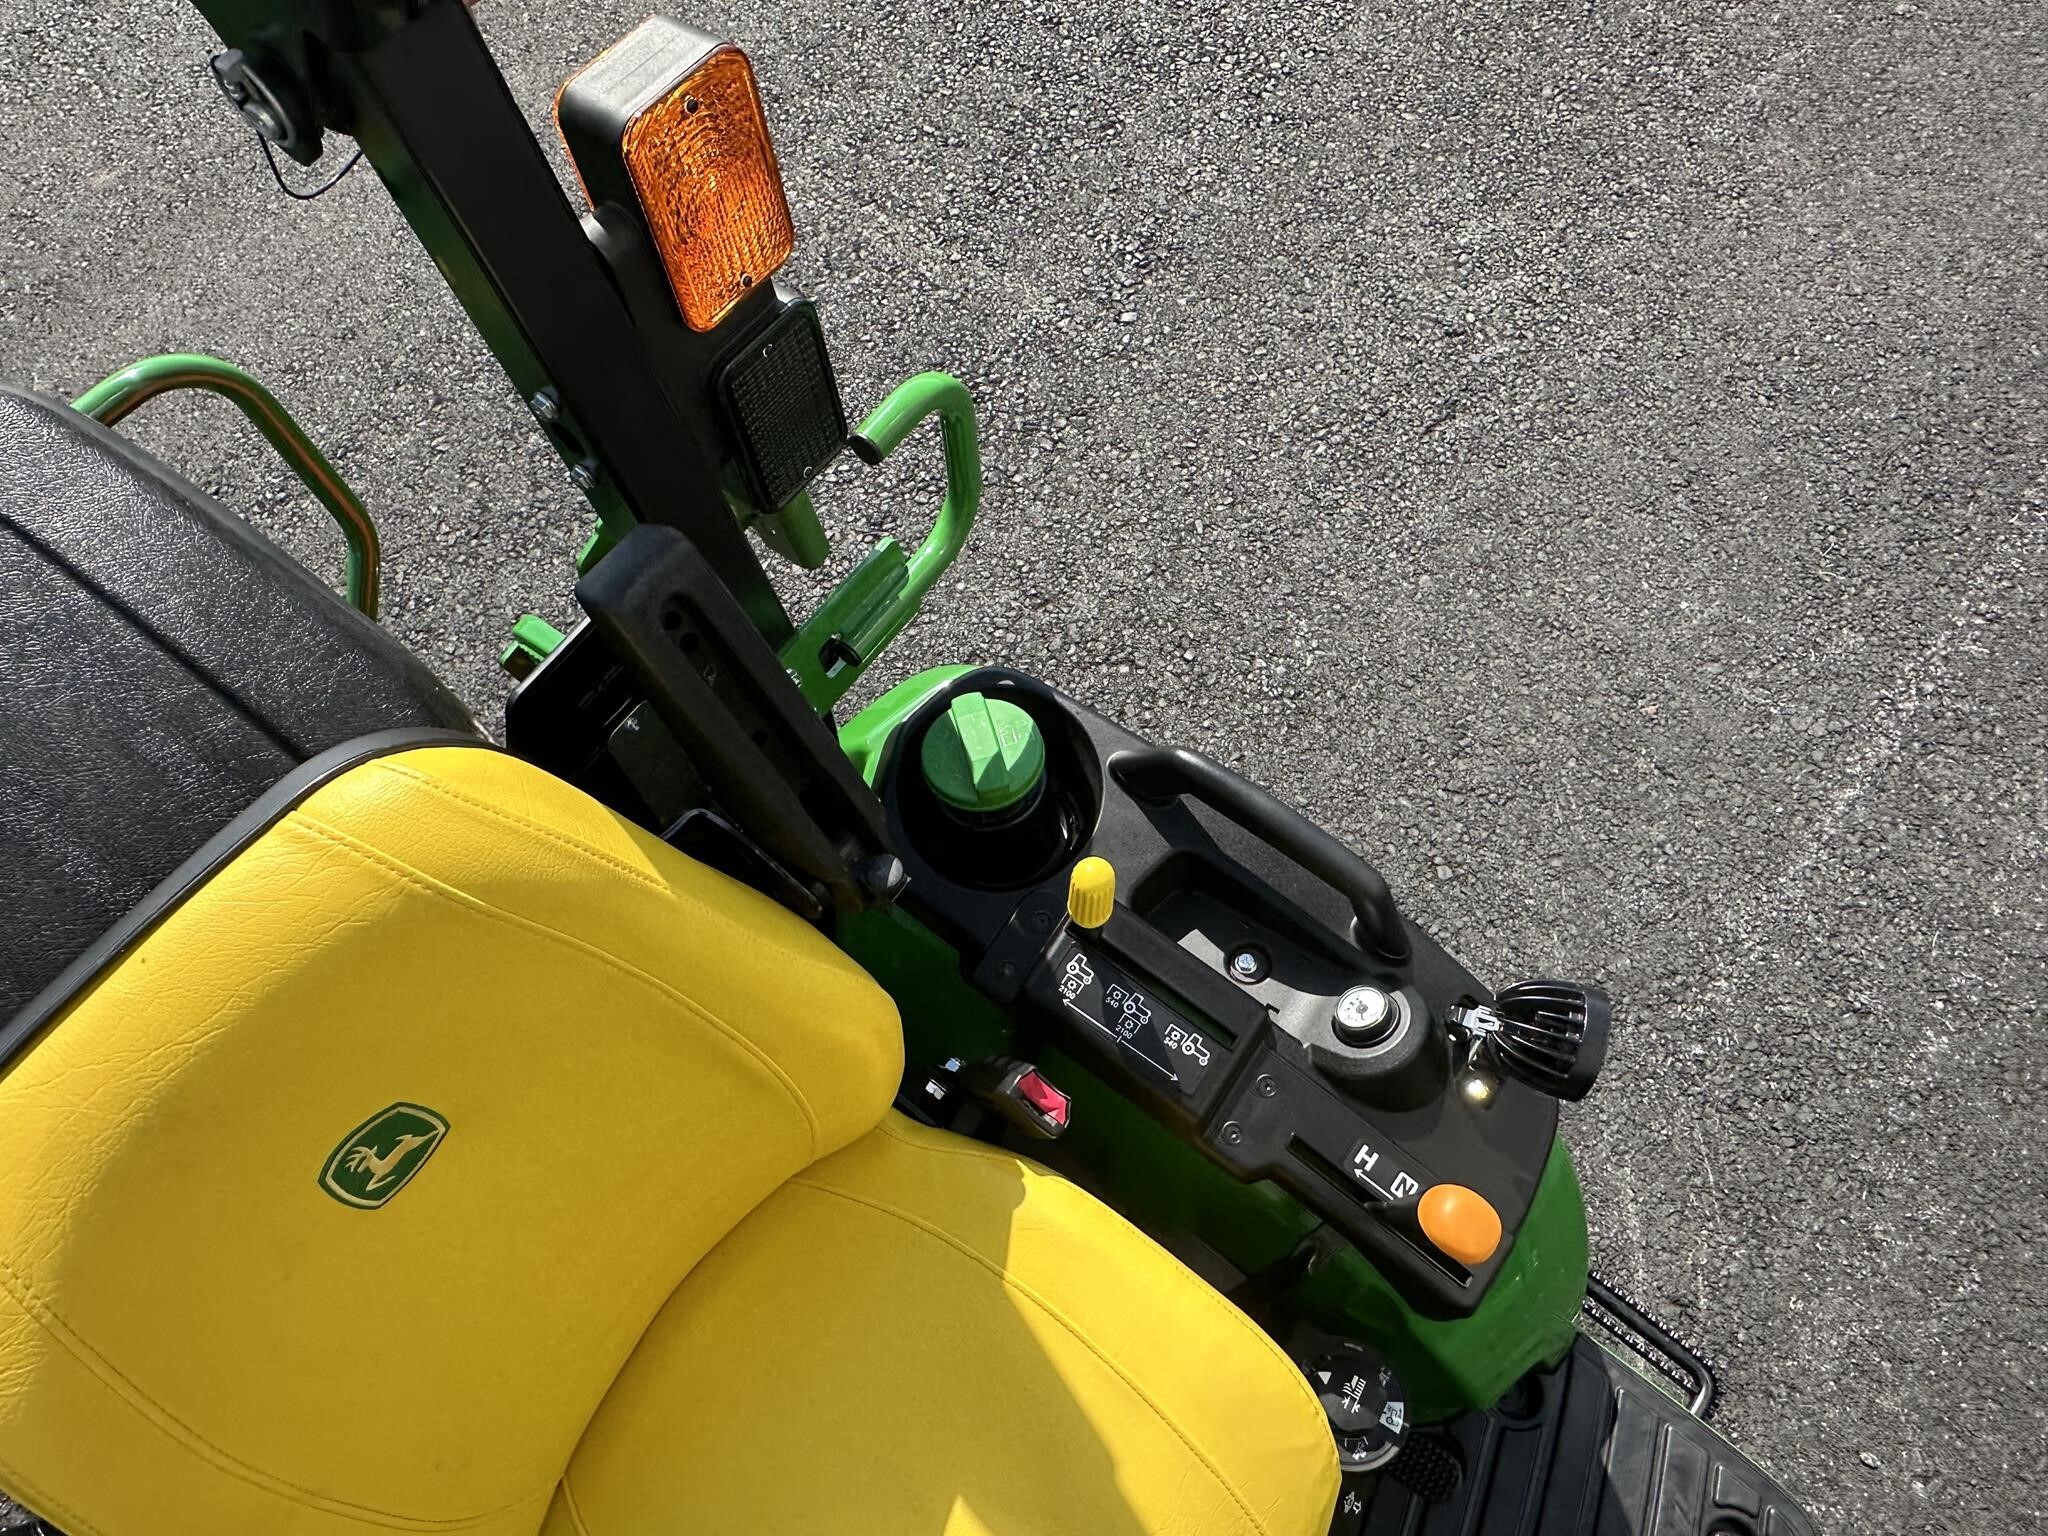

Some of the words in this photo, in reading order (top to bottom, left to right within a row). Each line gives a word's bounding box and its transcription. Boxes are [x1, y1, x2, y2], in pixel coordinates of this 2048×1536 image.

[1058, 985, 1075, 999] 2100
[1105, 996, 1118, 1009] 540
[1115, 1024, 1133, 1039] 2100
[1164, 1037, 1178, 1050] 540
[1354, 1144, 1380, 1172] H
[1392, 1174, 1416, 1197] N
